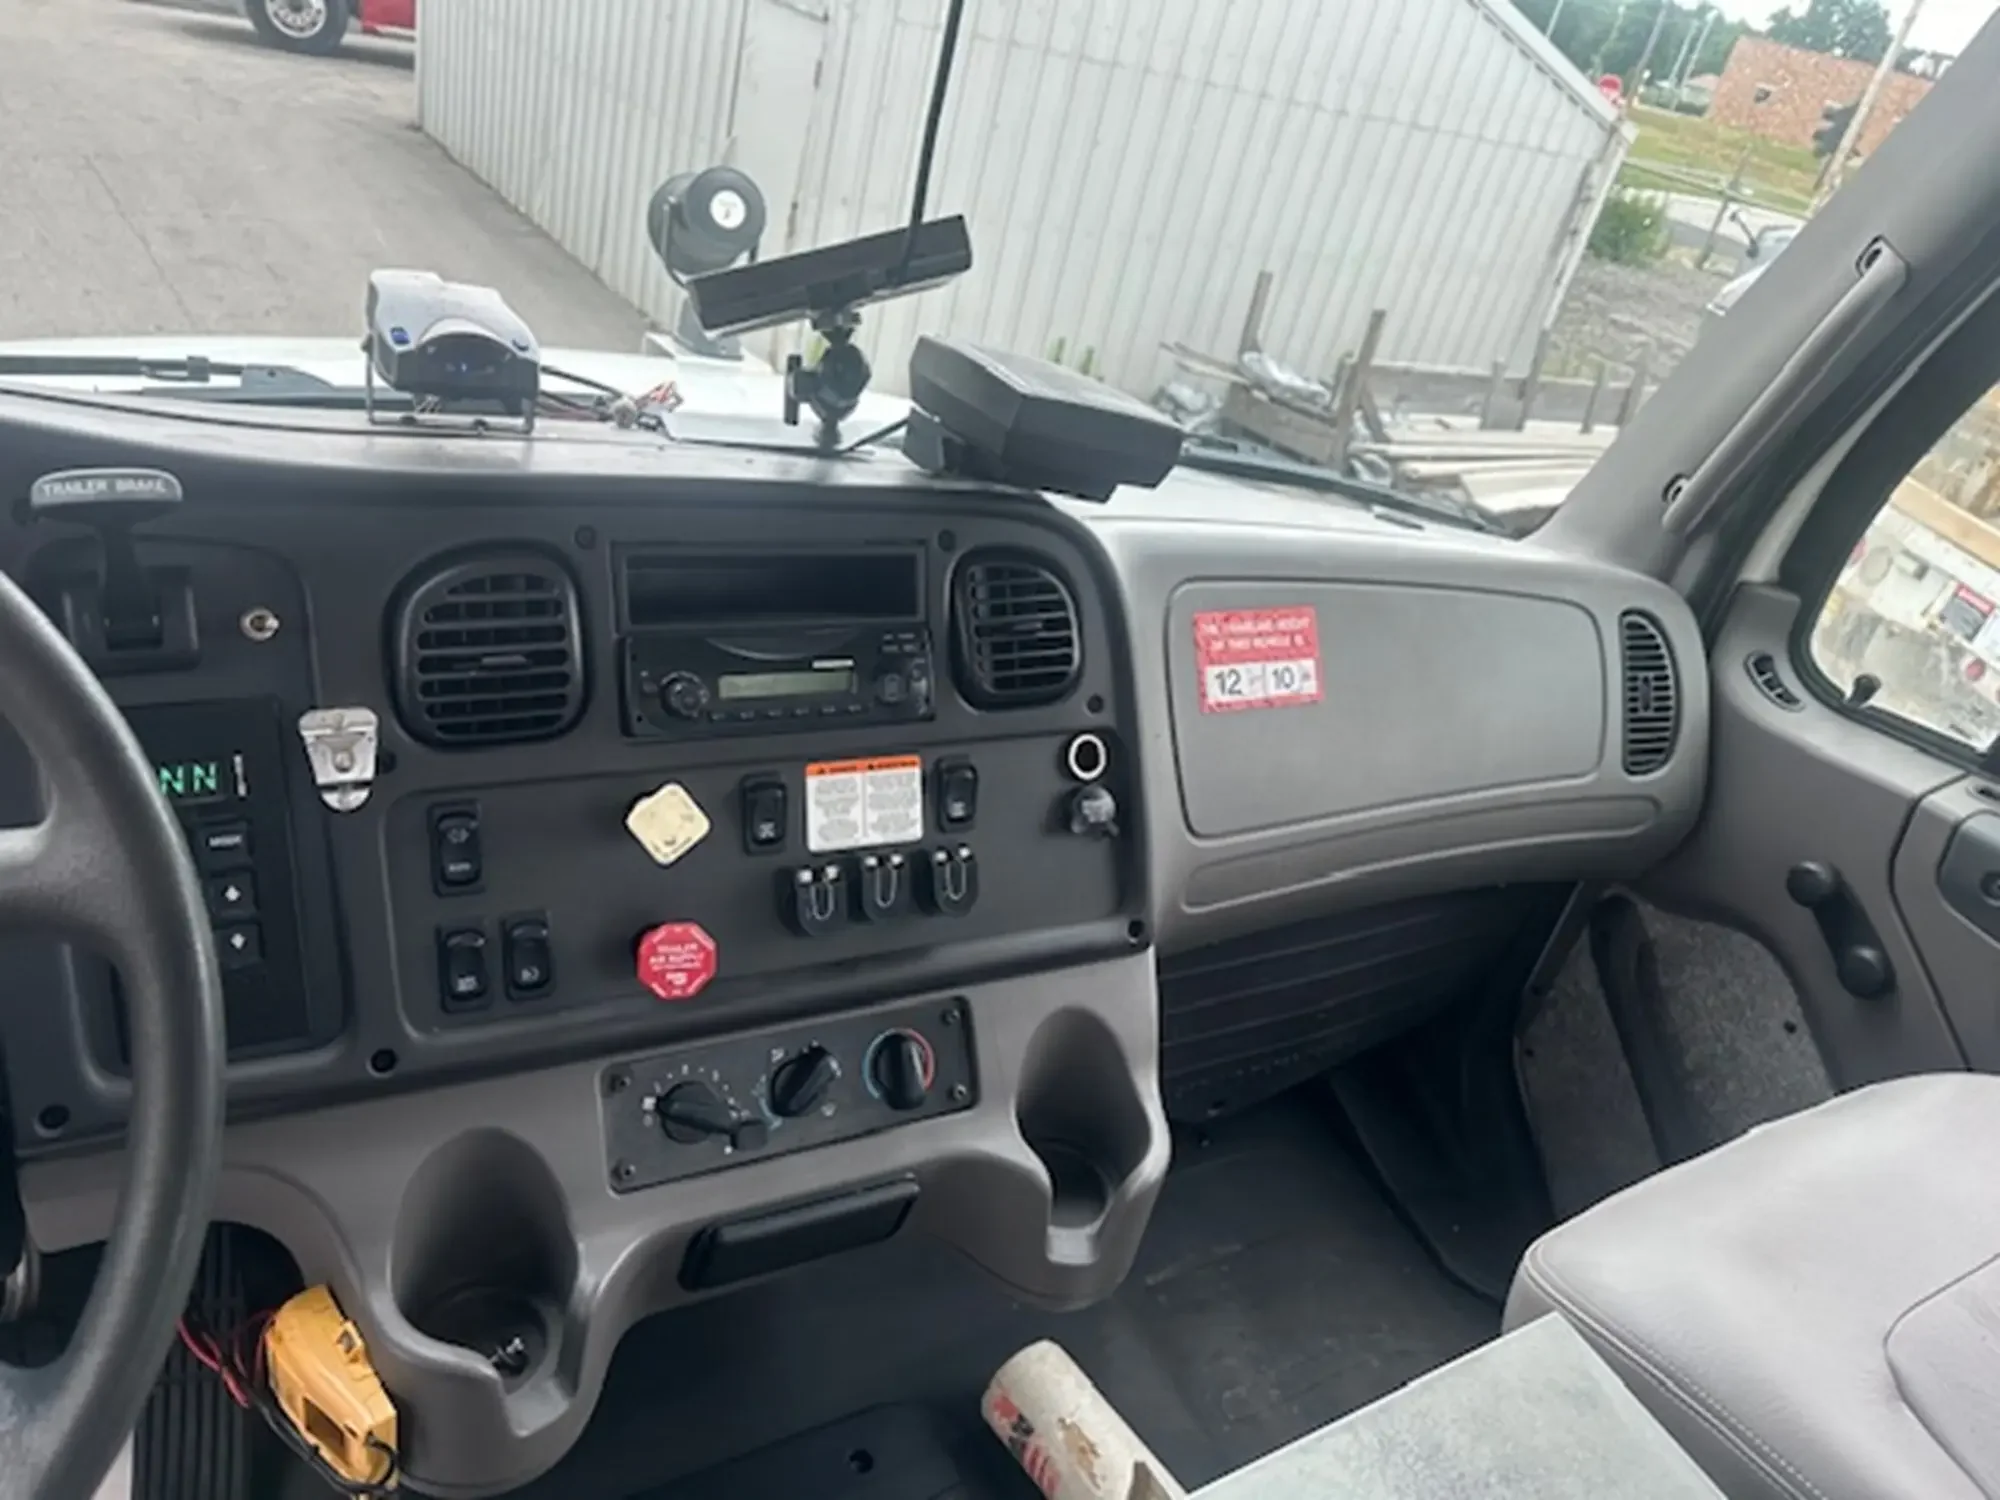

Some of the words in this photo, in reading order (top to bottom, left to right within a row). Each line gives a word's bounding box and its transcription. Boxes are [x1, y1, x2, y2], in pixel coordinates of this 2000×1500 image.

[41, 479, 107, 497] TRAILER
[115, 478, 167, 494] BRAKE
[1214, 668, 1242, 695] 12
[1272, 666, 1295, 690] 10
